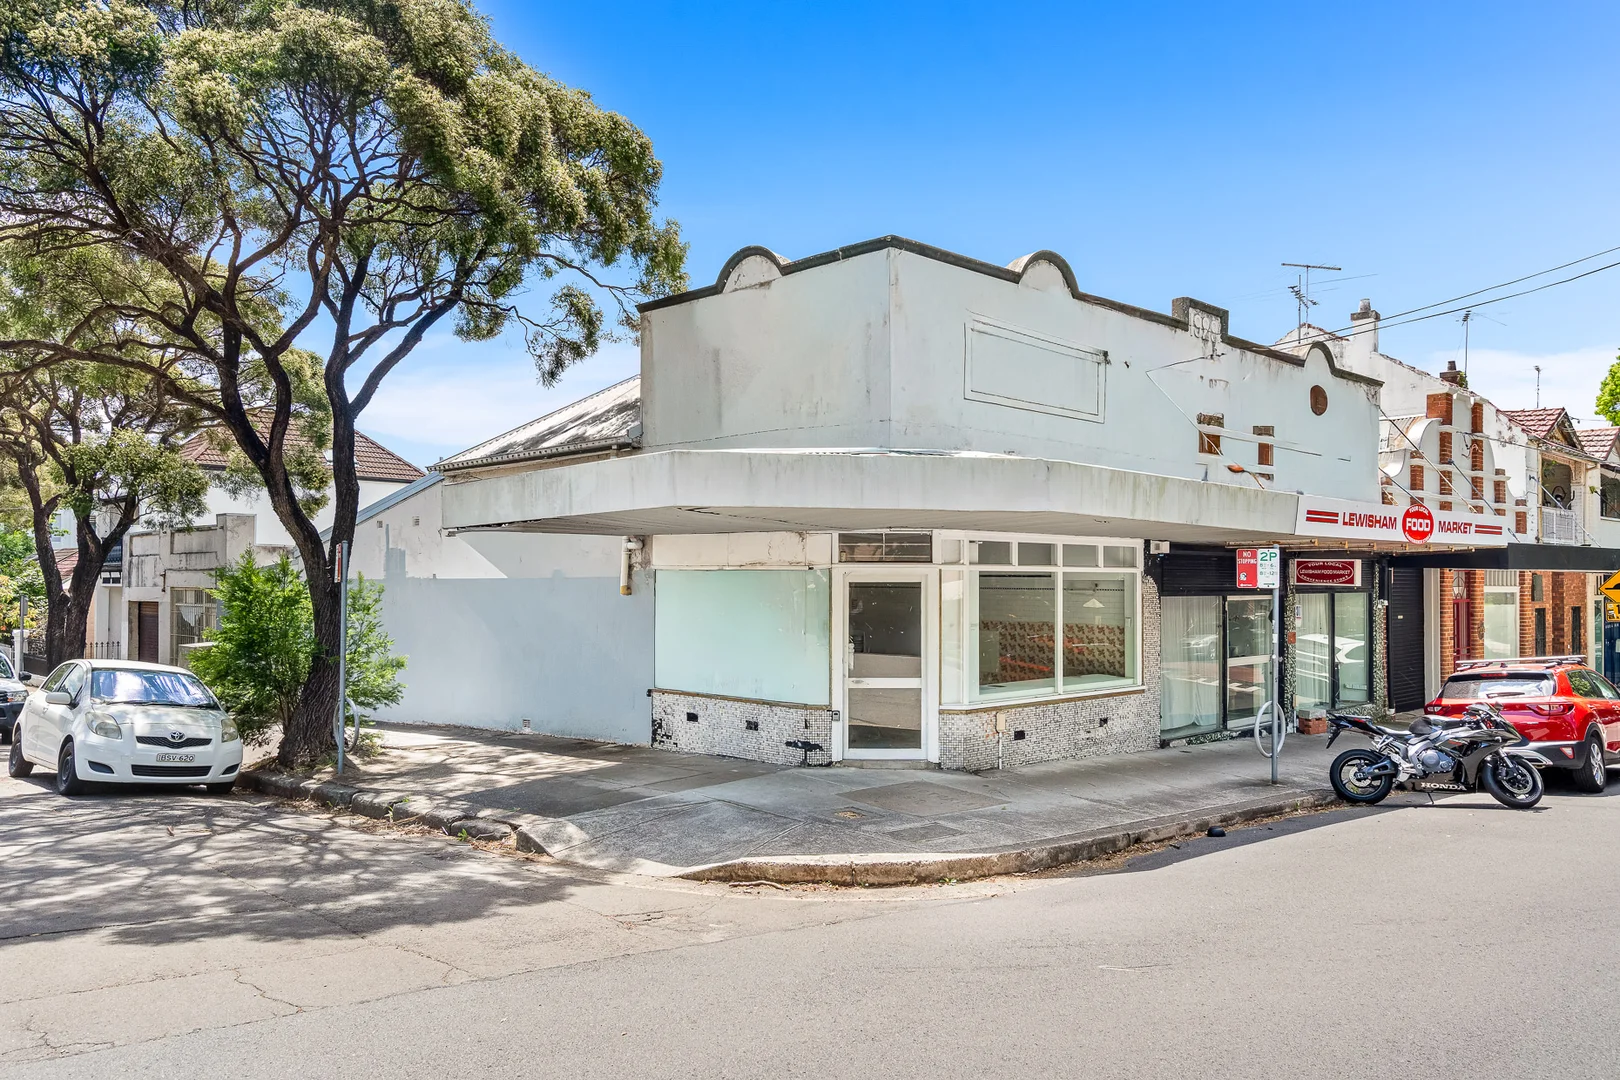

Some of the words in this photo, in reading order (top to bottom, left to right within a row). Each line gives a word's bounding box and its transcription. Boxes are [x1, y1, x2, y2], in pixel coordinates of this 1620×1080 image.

[1342, 512, 1397, 530] LEWISHAM
[1406, 518, 1431, 532] FOOD
[1438, 520, 1473, 534] MARKET
[1260, 552, 1278, 561] 2P
[1420, 782, 1467, 791] HONDA
